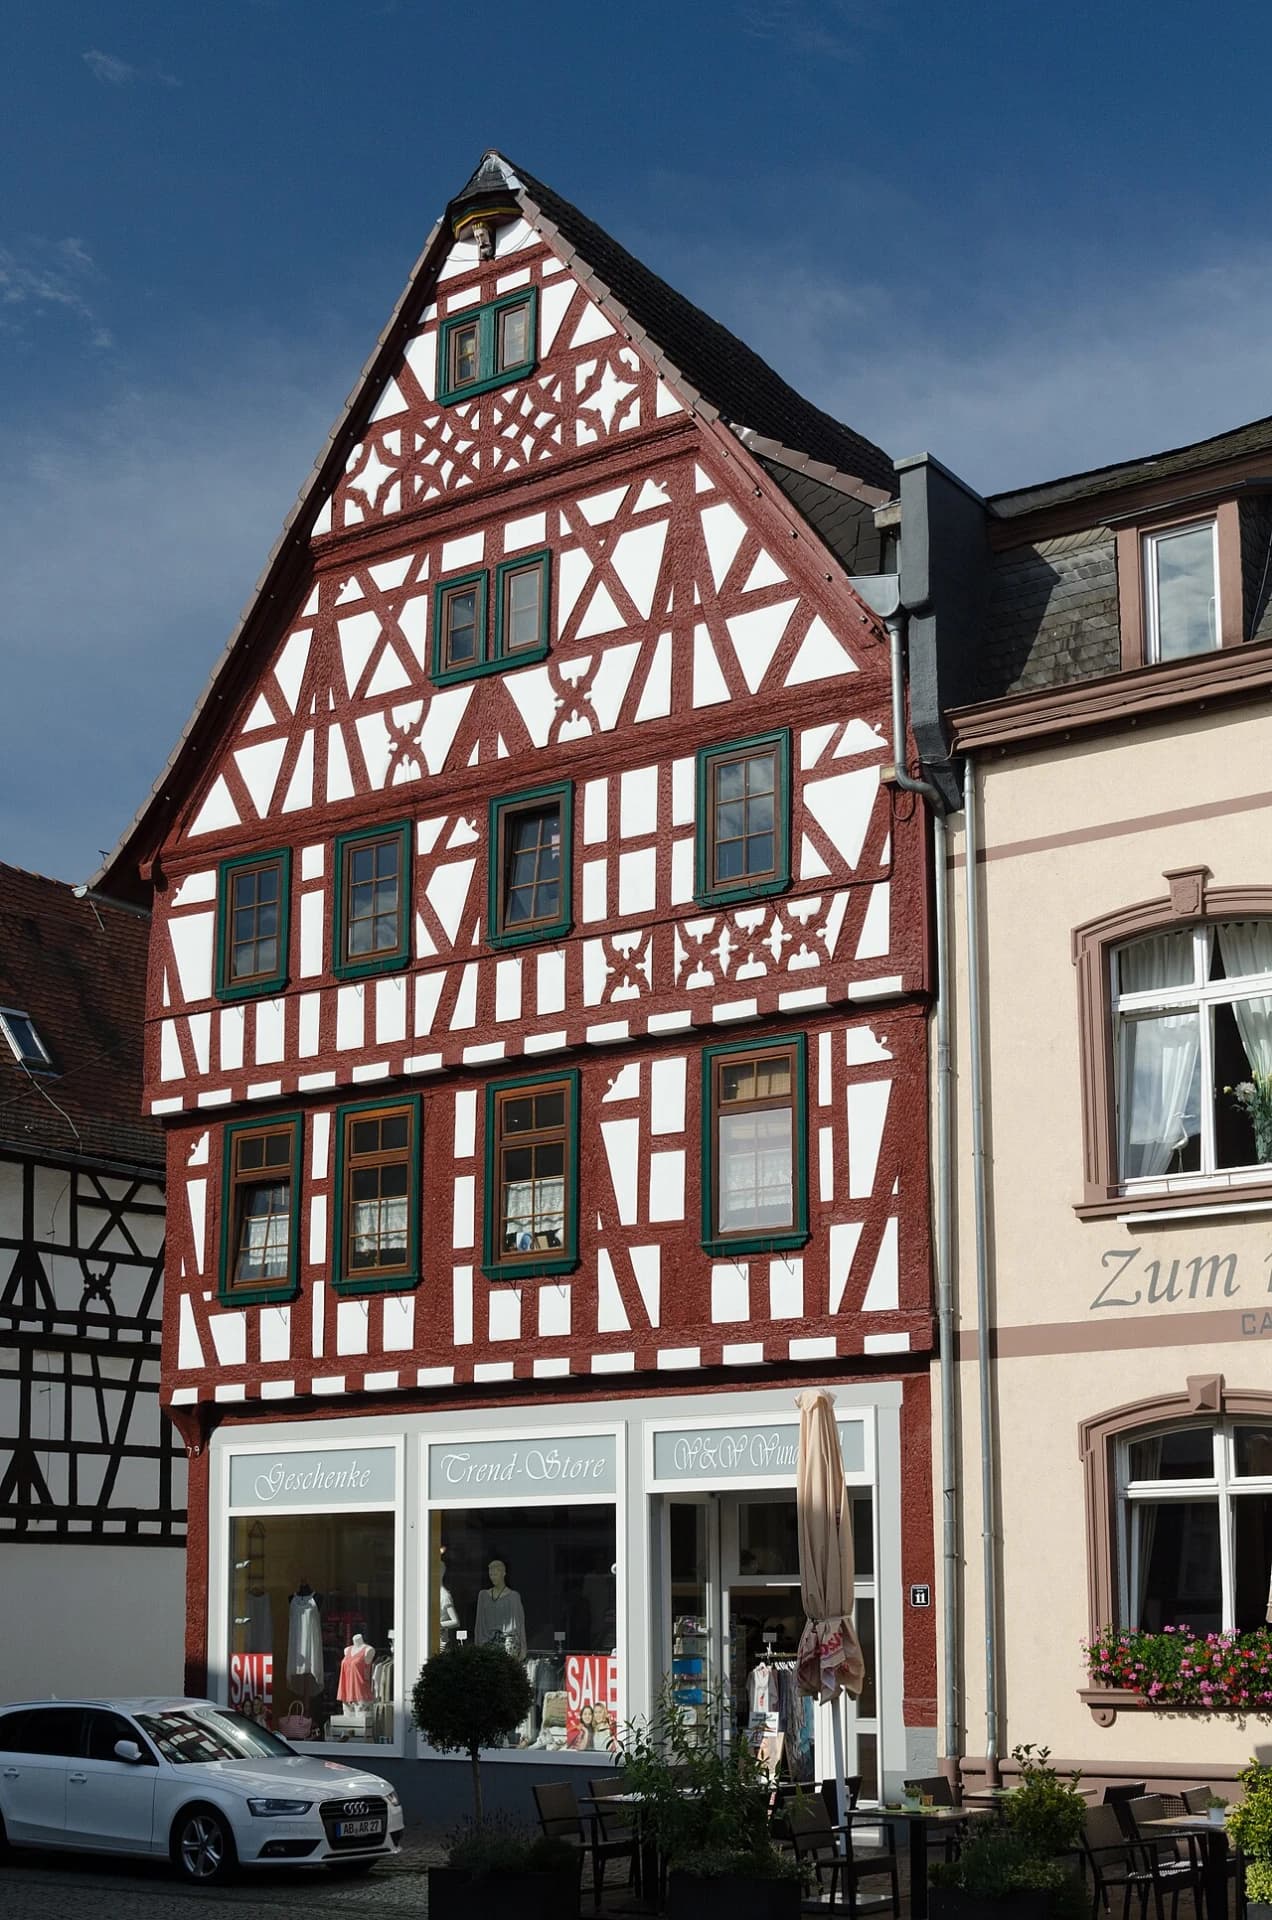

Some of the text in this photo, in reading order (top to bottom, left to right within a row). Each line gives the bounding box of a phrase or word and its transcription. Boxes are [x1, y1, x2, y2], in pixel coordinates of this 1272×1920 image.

[1090, 1246, 1241, 1310] Zum
[254, 1460, 371, 1501] Geschenke
[440, 1449, 606, 1483] Trend-Store
[914, 1592, 927, 1604] 11
[231, 1655, 272, 1704] SALE
[567, 1657, 617, 1711] SALE
